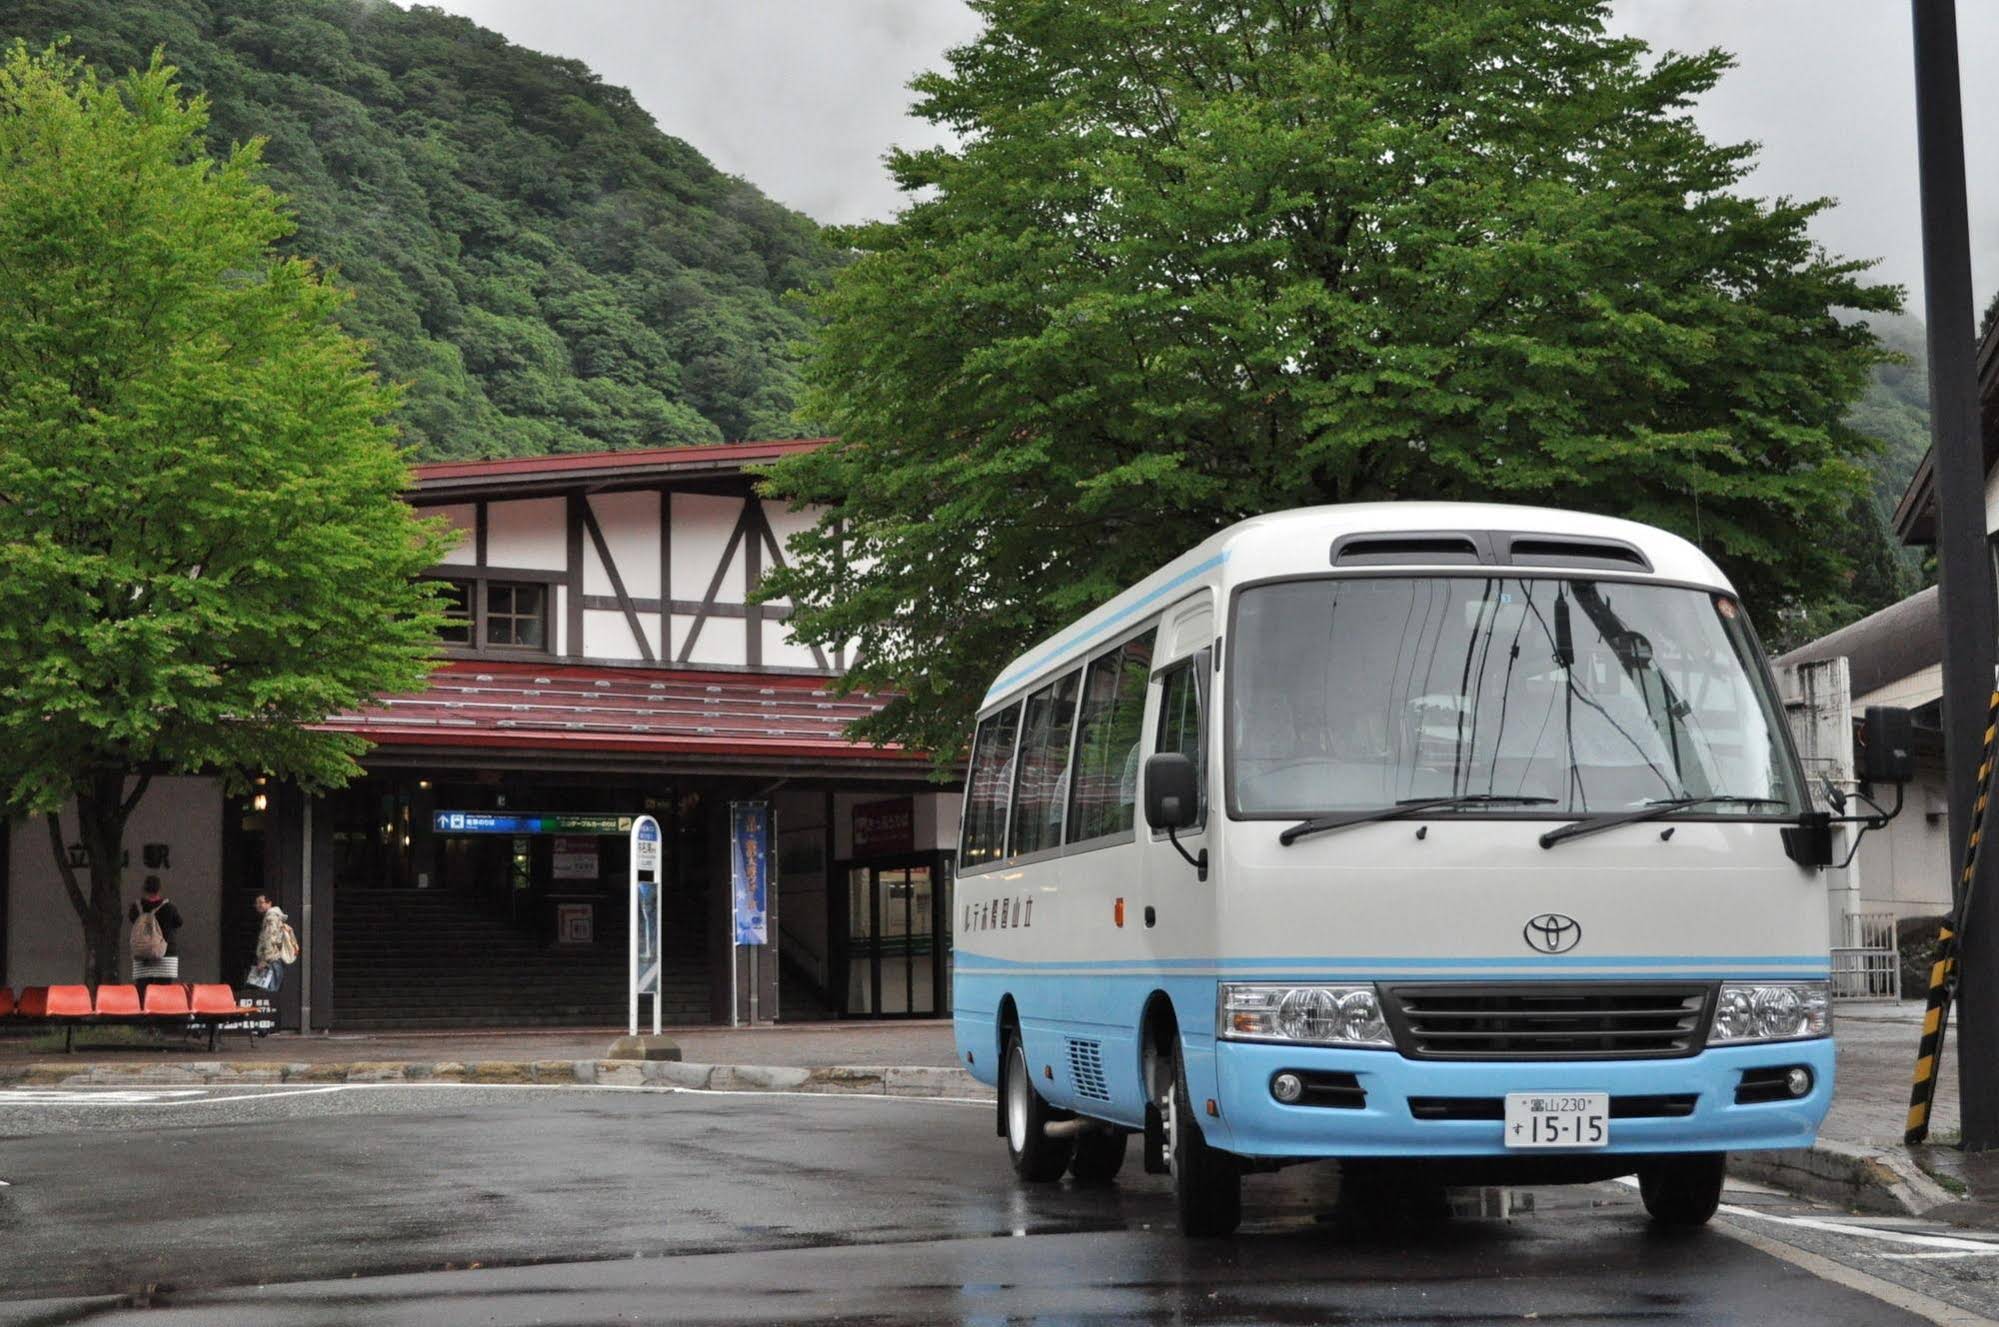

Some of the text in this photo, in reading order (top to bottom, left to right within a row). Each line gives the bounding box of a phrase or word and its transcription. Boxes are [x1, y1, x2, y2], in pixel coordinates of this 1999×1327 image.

[67, 843, 171, 869] 立駅
[1530, 1098, 1586, 1113] 富山230
[1531, 1115, 1603, 1143] 15-15
